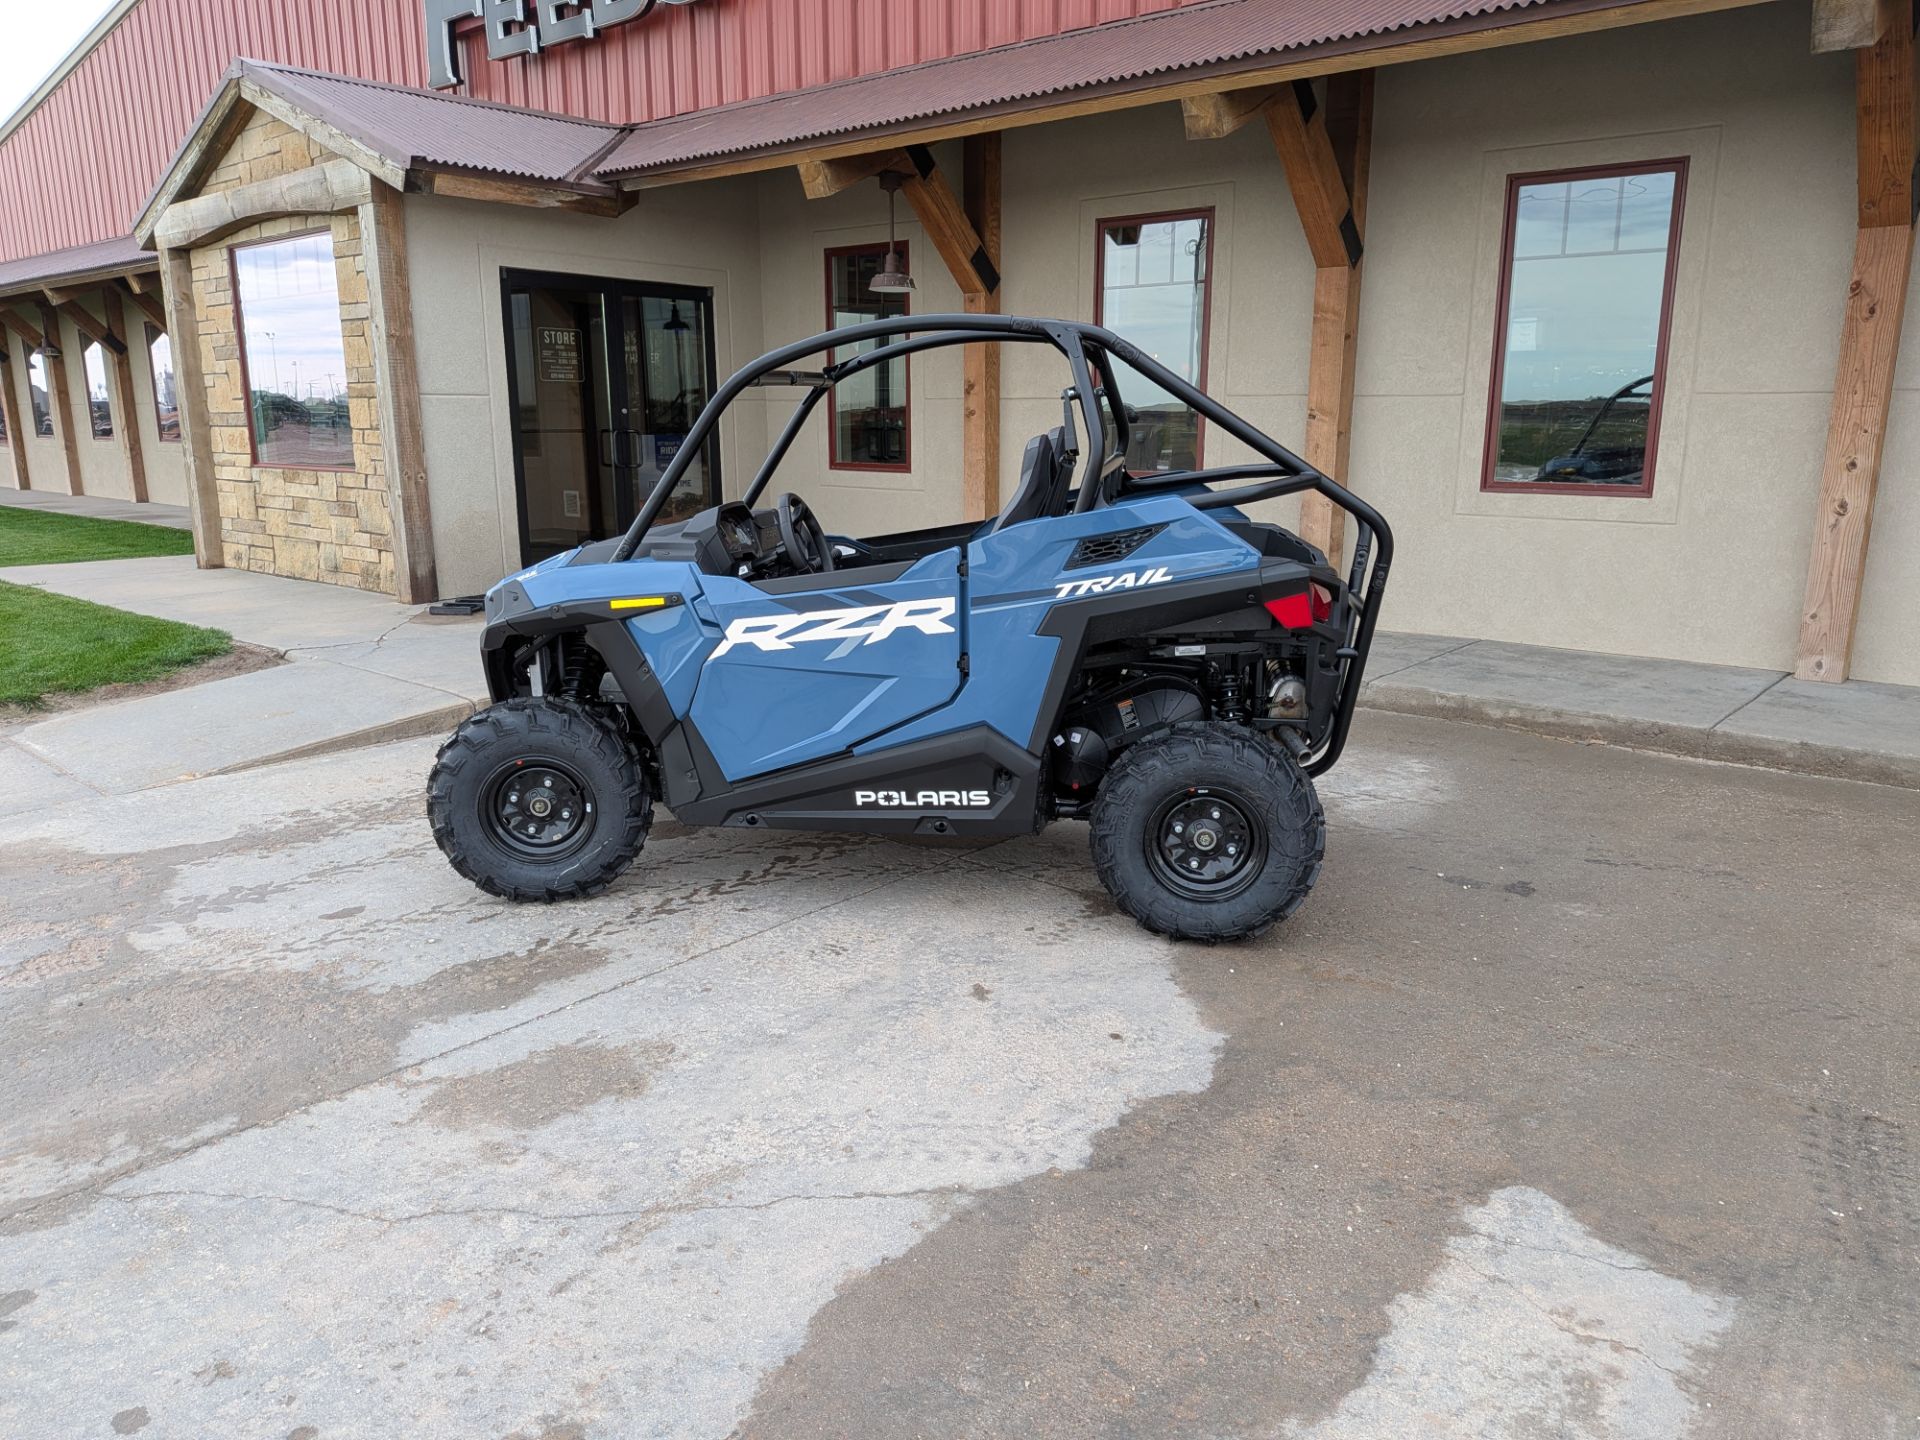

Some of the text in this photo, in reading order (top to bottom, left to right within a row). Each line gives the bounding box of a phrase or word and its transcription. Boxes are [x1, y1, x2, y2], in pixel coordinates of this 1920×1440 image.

[544, 331, 576, 345] STORE
[1055, 567, 1174, 599] TRAIL
[707, 596, 956, 660] RZR
[854, 790, 991, 806] POLARIS
